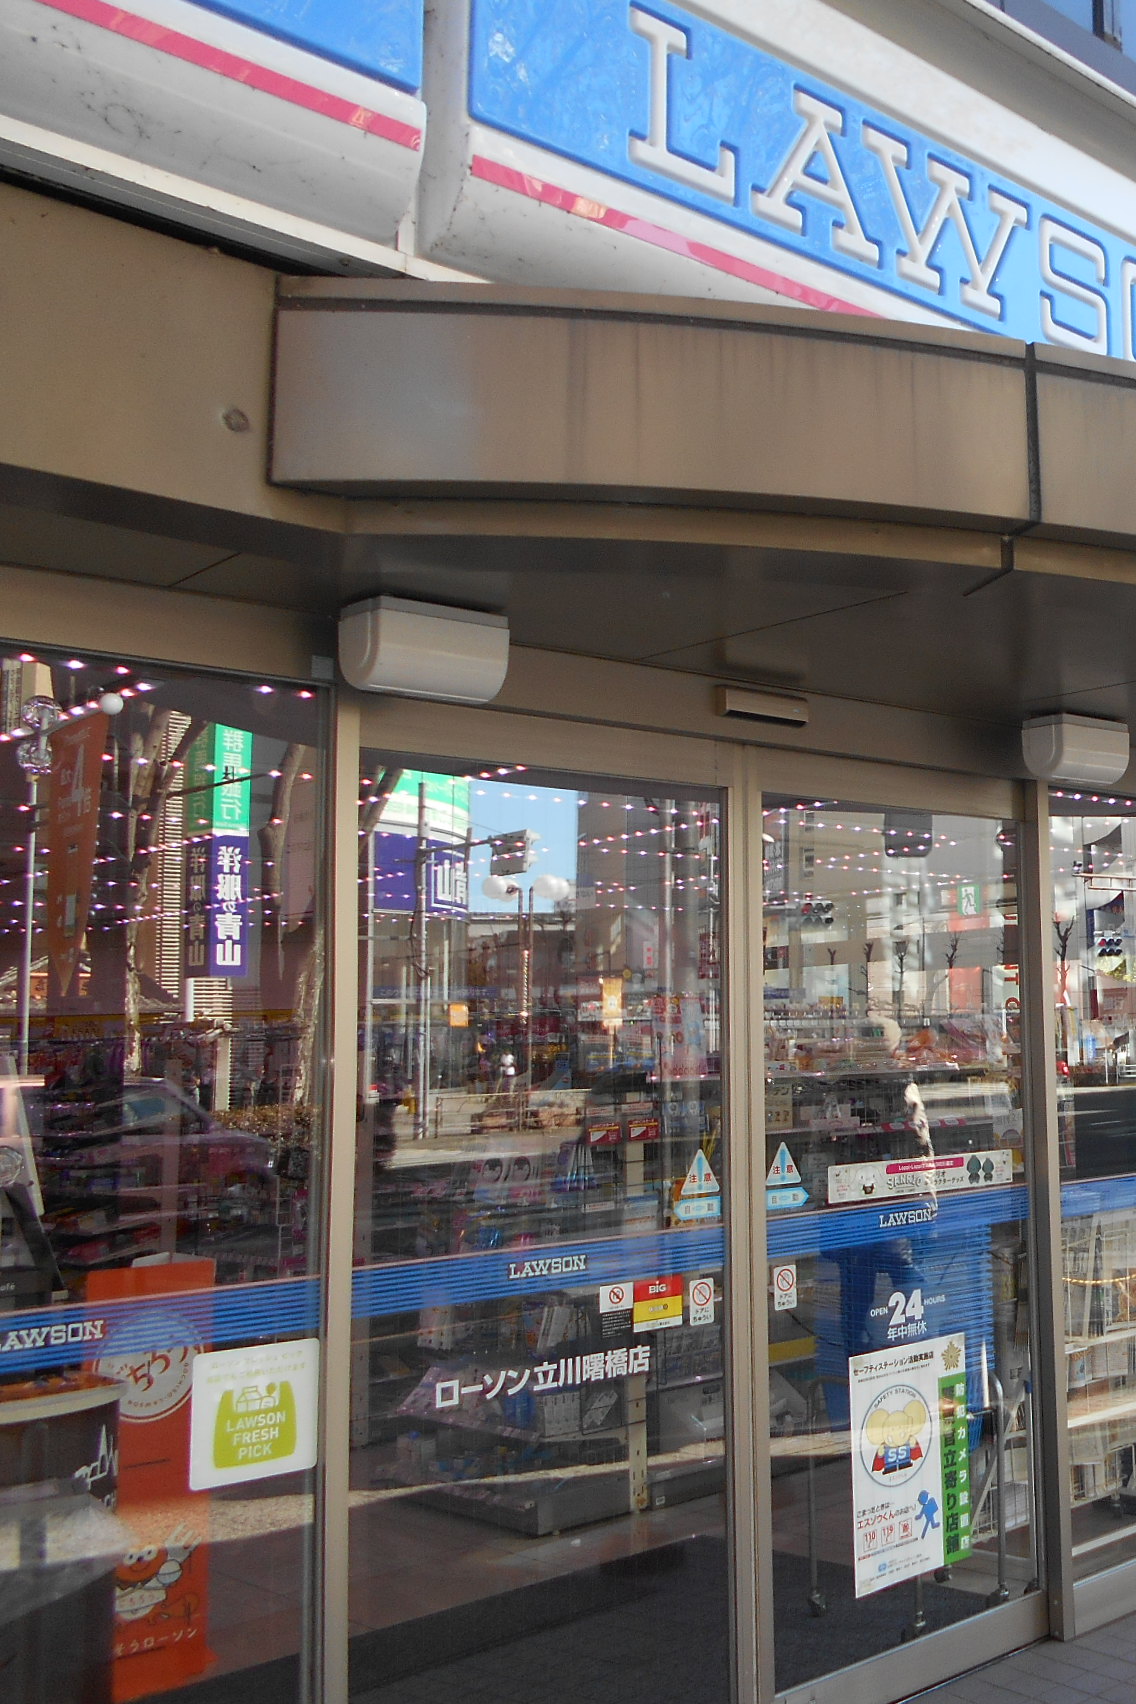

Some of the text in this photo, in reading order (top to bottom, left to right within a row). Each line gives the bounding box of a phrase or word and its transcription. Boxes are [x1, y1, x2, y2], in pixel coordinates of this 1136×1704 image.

[879, 1209, 933, 1228] LAWSON
[508, 1254, 587, 1279] LAWSON
[870, 1288, 946, 1326] OPEN 24 HOURS
[0, 1320, 104, 1350] AWSON
[887, 1320, 928, 1341] 年中無休
[226, 1410, 287, 1433] LAWSON
[233, 1428, 280, 1446] FRESH
[238, 1442, 273, 1460] PICK
